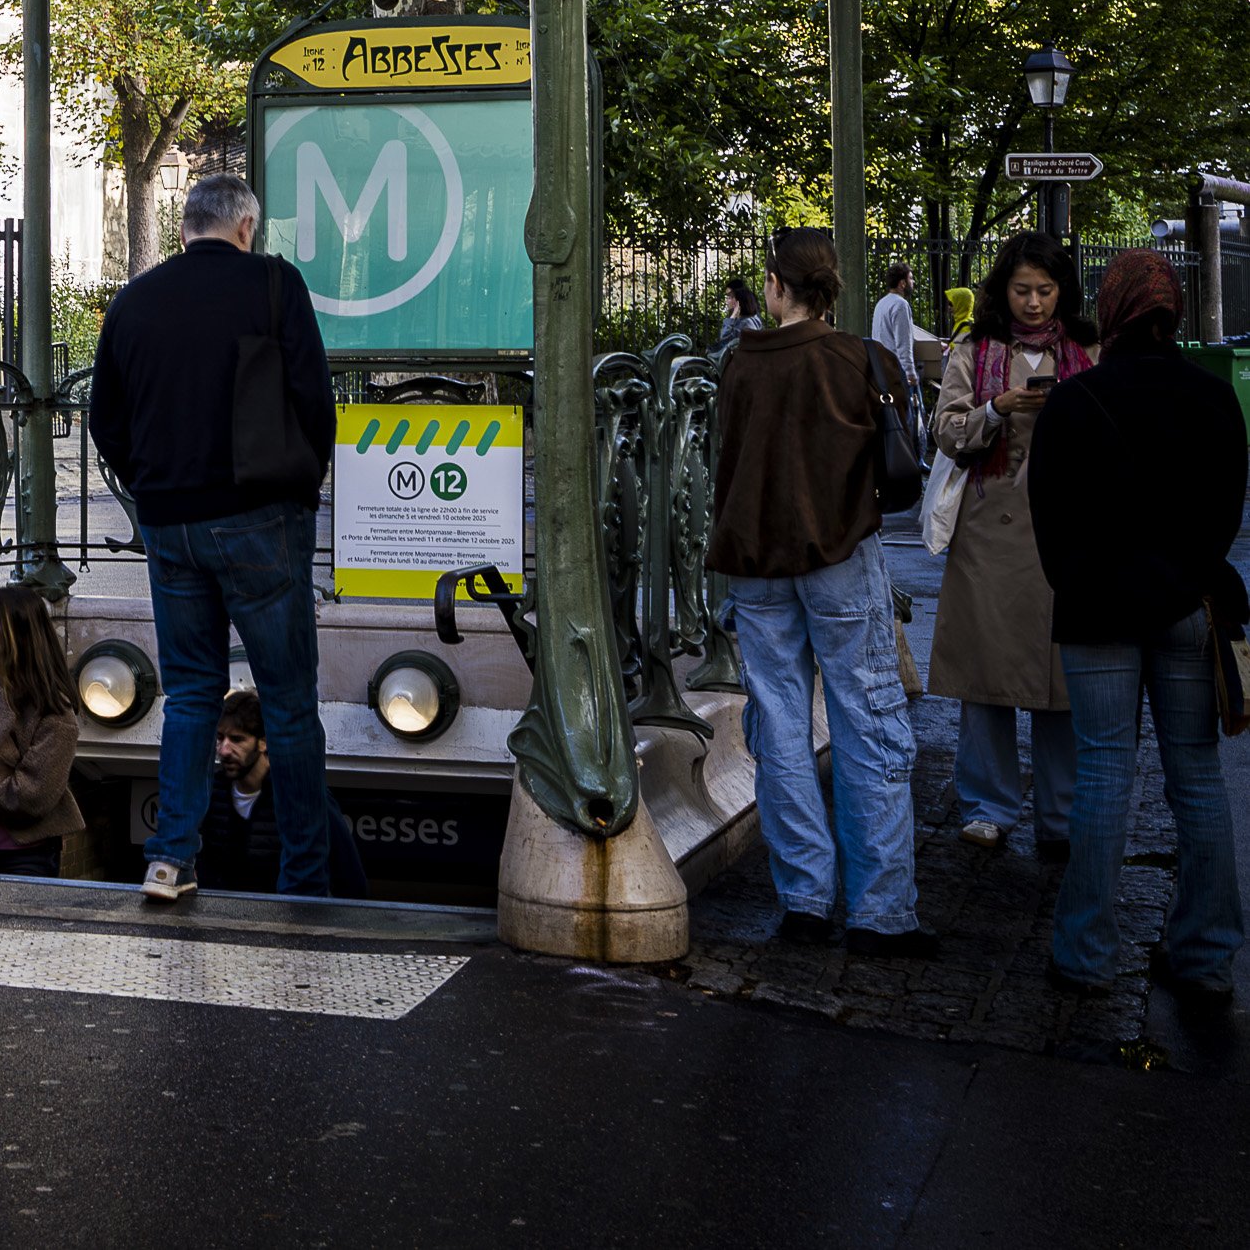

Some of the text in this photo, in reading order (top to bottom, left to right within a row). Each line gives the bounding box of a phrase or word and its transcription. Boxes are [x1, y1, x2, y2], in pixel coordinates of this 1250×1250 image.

[516, 40, 530, 50] LIGN
[312, 58, 324, 71] 12
[297, 140, 407, 261] M
[397, 470, 462, 493] M 12
[343, 814, 458, 845] esses
